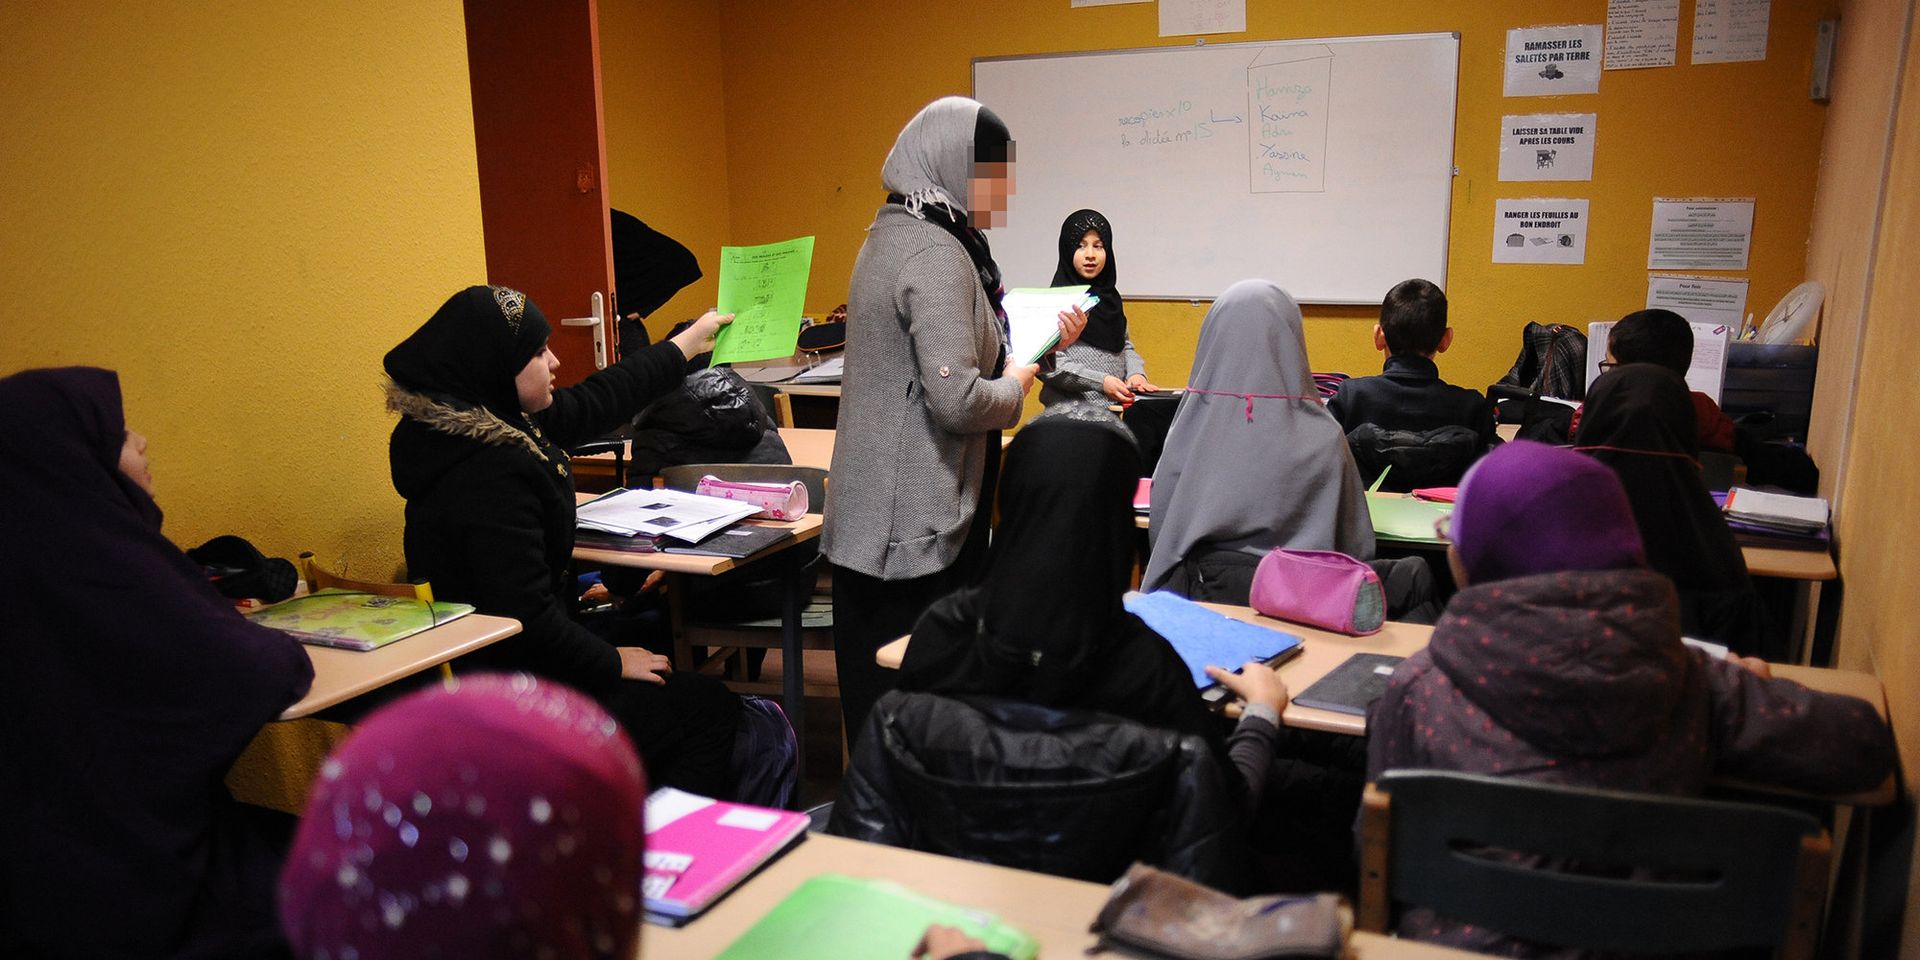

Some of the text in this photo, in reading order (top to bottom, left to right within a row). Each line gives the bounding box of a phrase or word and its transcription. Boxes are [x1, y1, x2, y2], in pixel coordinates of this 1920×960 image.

[1524, 39, 1583, 51] RAMASSER LES
[1515, 51, 1590, 64] SALETÉS PAR TERRE
[1512, 126, 1584, 136] LAISSER SA TABLE VIDE
[1541, 137, 1552, 145] LES
[1552, 136, 1575, 145] COURS
[1504, 211, 1579, 219] RANGER LES FEUILLES AU
[1519, 220, 1561, 229] BON ENDROIT
